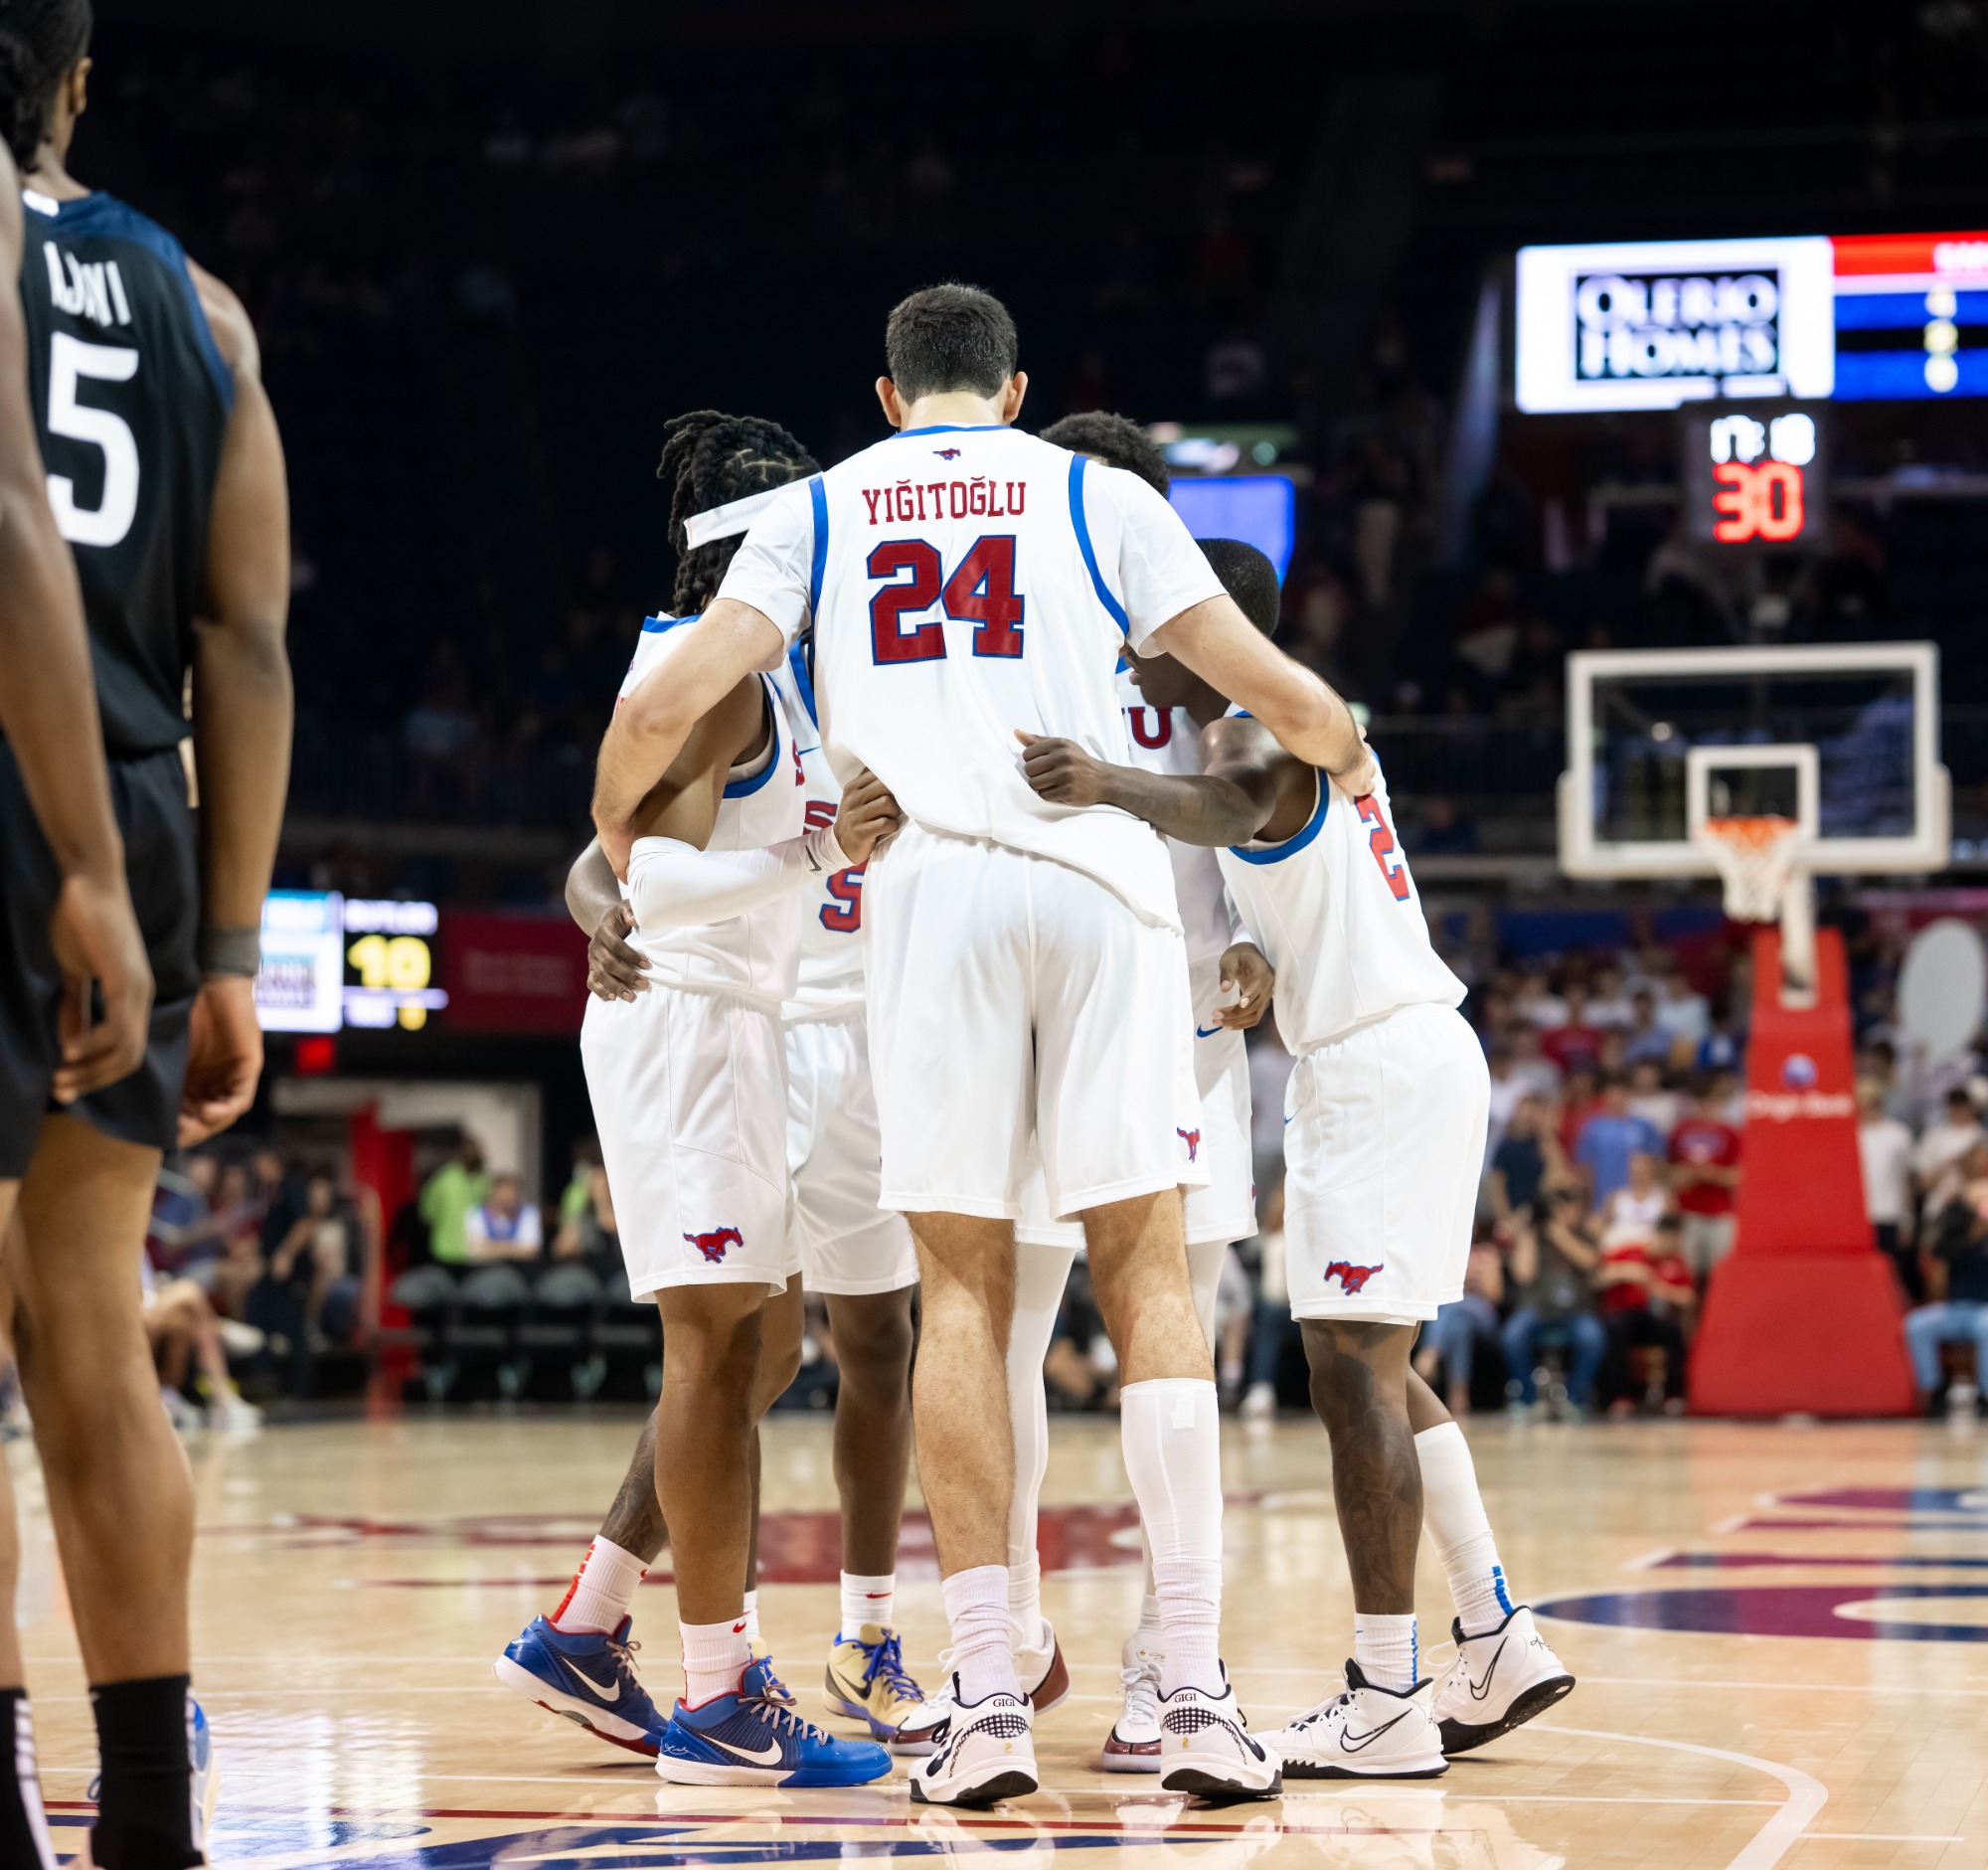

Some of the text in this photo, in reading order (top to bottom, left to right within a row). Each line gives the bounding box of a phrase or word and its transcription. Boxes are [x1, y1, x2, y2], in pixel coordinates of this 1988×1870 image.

[47, 330, 140, 548] 5
[862, 475, 1026, 525] YIĞITOĞLU
[1713, 459, 1804, 543] 30
[866, 534, 1025, 666] 24
[1121, 705, 1173, 751] U
[347, 934, 431, 991] 10
[992, 1698, 1016, 1708] GIGI
[1174, 1693, 1197, 1703] GIGI
